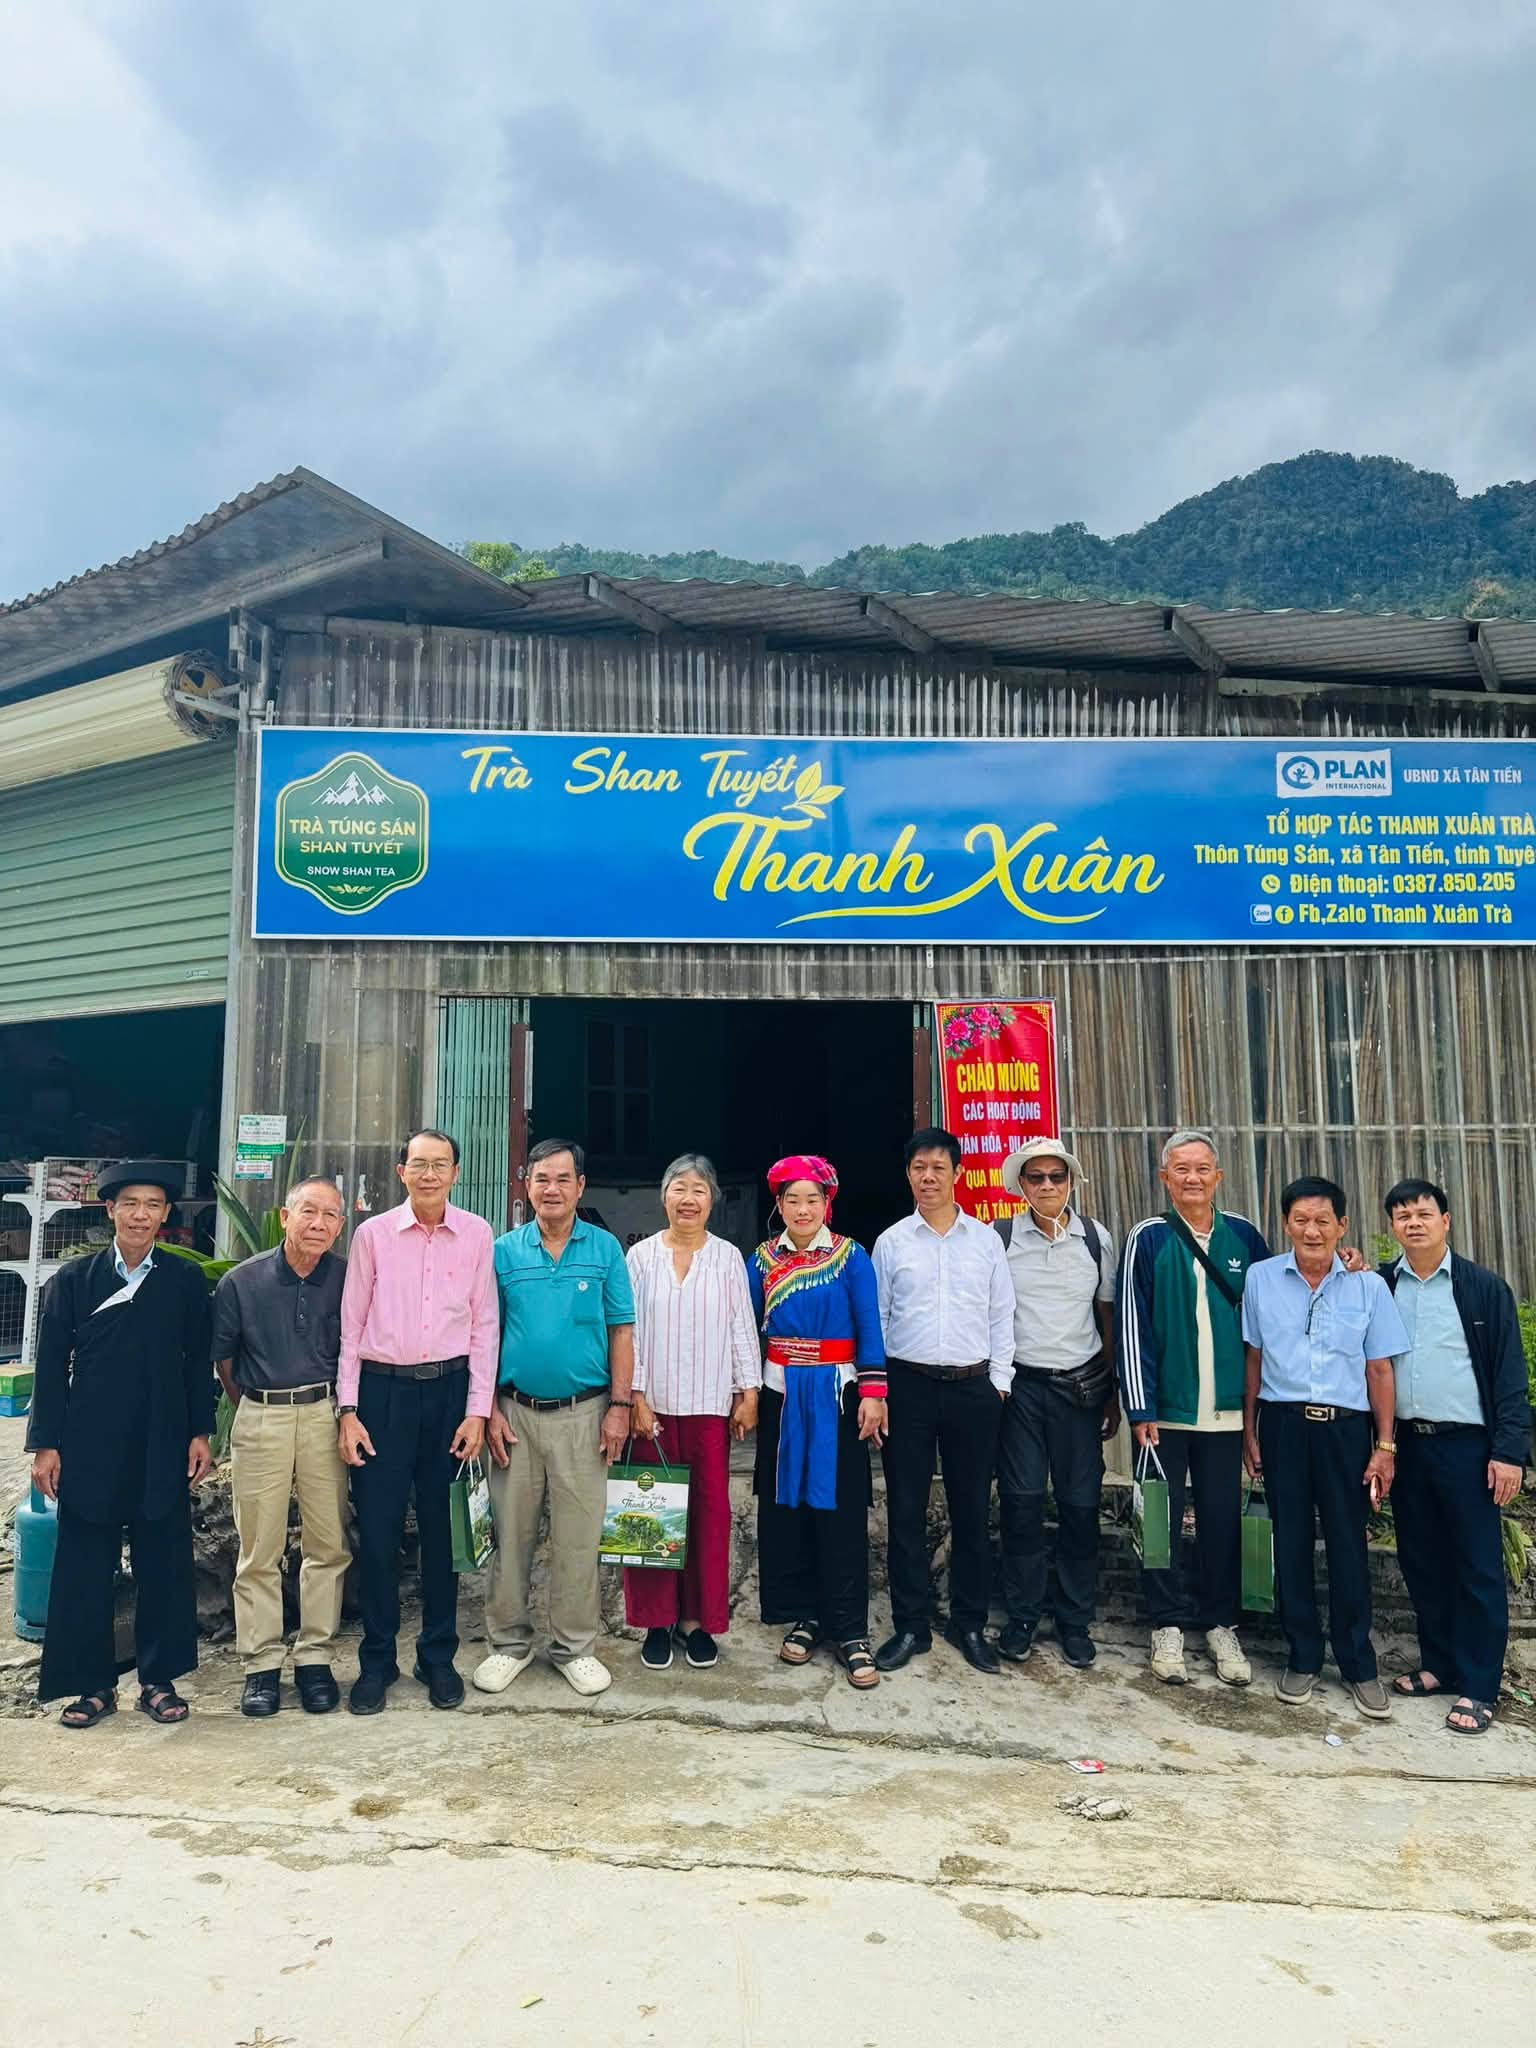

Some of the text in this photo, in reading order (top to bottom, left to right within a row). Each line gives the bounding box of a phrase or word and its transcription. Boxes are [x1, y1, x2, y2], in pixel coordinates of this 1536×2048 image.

[461, 745, 797, 808] Trà Shan Tuyết
[1324, 759, 1386, 779] PLAN
[1403, 765, 1523, 784] UBND XÃ TÂN TIẾN
[1325, 782, 1387, 790] INTERNATIONAL
[289, 815, 416, 836] TRÀ TÚNG SÁN
[1266, 807, 1535, 839] TỔ HỢP TÁC THANH XUÂN TRÀ
[300, 838, 404, 854] SHAN TUYẾT
[1194, 841, 1536, 868] Thôn Túng Sán, xã Tân Tiến, tỉnh Tuyê
[307, 865, 396, 877] SNOW SHAN TEA
[682, 811, 1165, 924] Thanh Xuân
[1290, 872, 1515, 897] Điện thoại: 0387.850.205
[1371, 903, 1427, 924] Thanh
[1433, 904, 1478, 924] Xuân
[1483, 903, 1513, 924] Trà
[956, 1056, 1040, 1094] CHÀO MỪNG
[962, 1098, 1041, 1124] CÁC HOẠT ĐỘNG
[981, 1131, 1003, 1154] HÓA
[975, 1199, 990, 1221] XÃ
[991, 1198, 1013, 1220] TÂN
